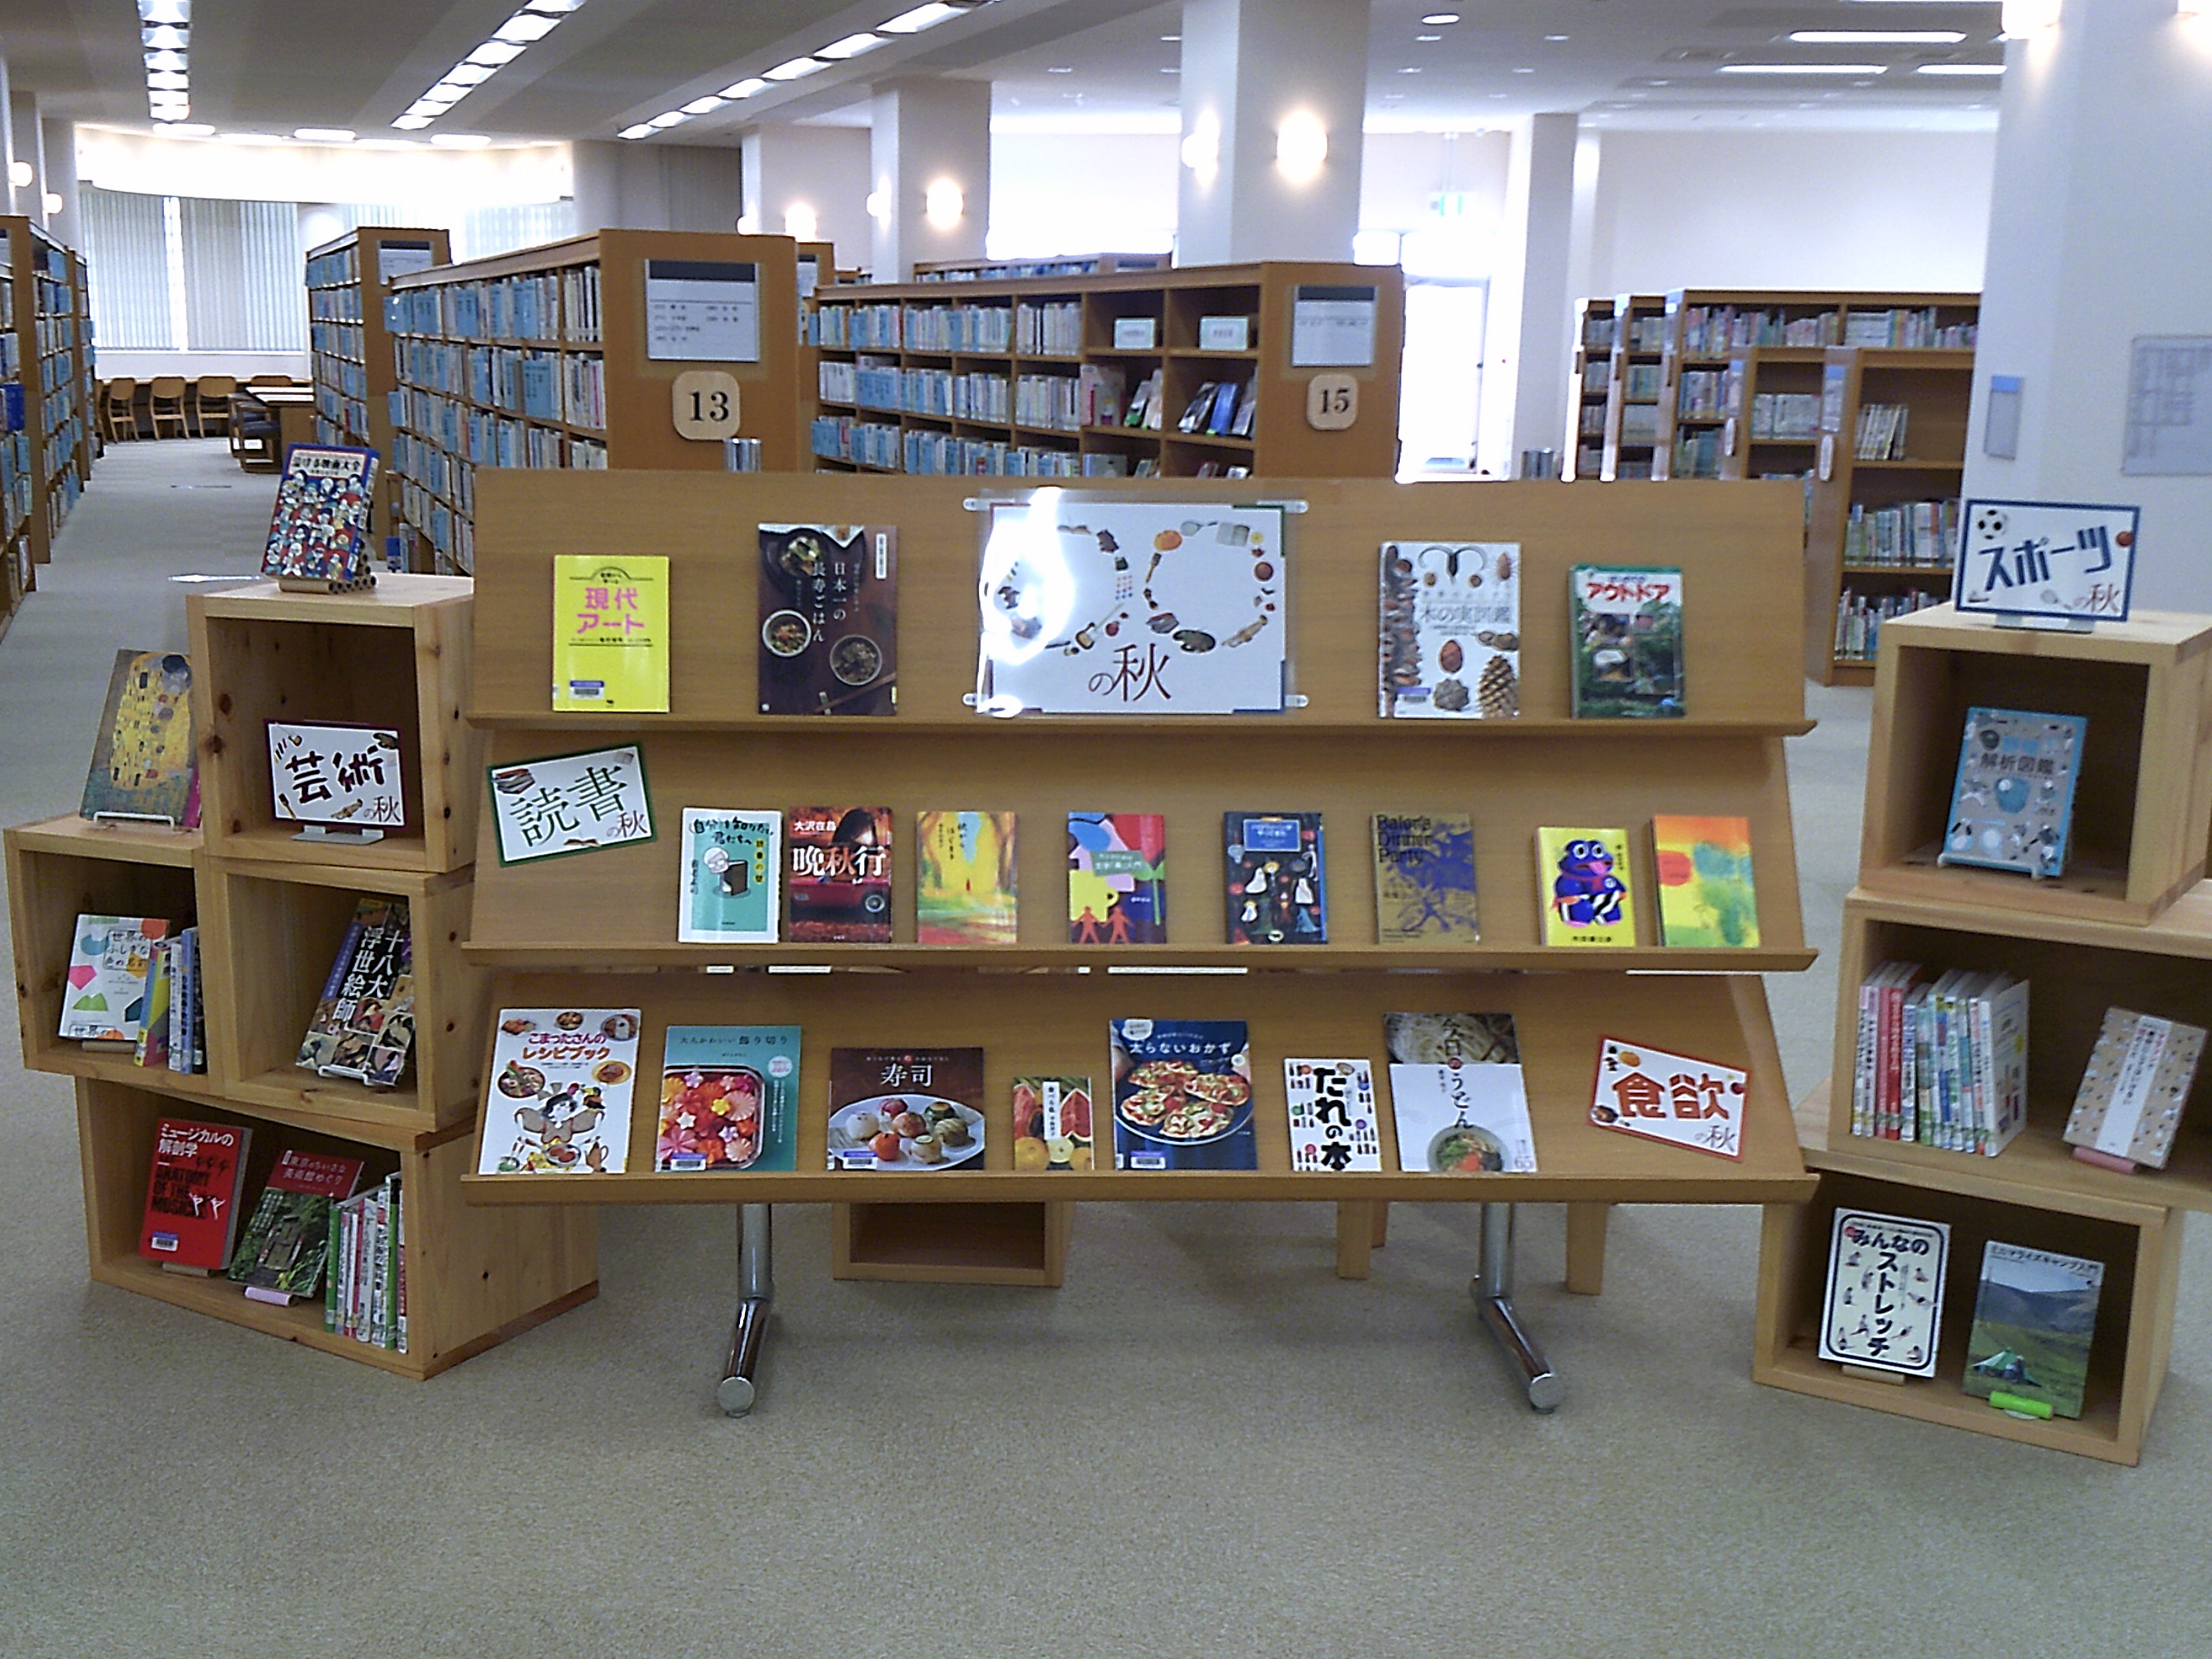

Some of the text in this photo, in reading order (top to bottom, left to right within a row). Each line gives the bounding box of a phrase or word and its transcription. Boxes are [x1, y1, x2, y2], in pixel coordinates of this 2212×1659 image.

[689, 390, 729, 422] 13
[1320, 387, 1349, 414] 15
[1978, 525, 2112, 592] スポーツ
[583, 587, 638, 611] 現代
[833, 561, 847, 621] 日本一の
[1586, 581, 1671, 602] アウトドア
[2074, 583, 2121, 613] の秋
[577, 613, 645, 634] アート
[1088, 642, 1172, 703] の秋
[284, 744, 385, 804] 芸術
[363, 795, 402, 823] の秋
[509, 765, 628, 848] 読書
[606, 809, 649, 839] の秋
[794, 820, 837, 832] 大沢在昌
[792, 844, 887, 877] 晩秋行
[331, 925, 385, 1023] 浮世絵師
[528, 1032, 607, 1045] こまったさんの
[1129, 1041, 1232, 1055] 太らないおかず
[522, 1046, 611, 1061] レシピブック
[880, 1062, 933, 1088] 寿司
[1442, 1018, 1474, 1129] 今日のうどん
[1612, 1071, 1729, 1120] 食欲
[1313, 1067, 1353, 1171] たれの本
[158, 1138, 198, 1158] 解剖学
[161, 1123, 234, 1147] ミュージカルの
[1694, 1125, 1736, 1152] の秋
[1851, 1229, 1930, 1256] みんなの
[1867, 1251, 1898, 1357] ストレッチ
